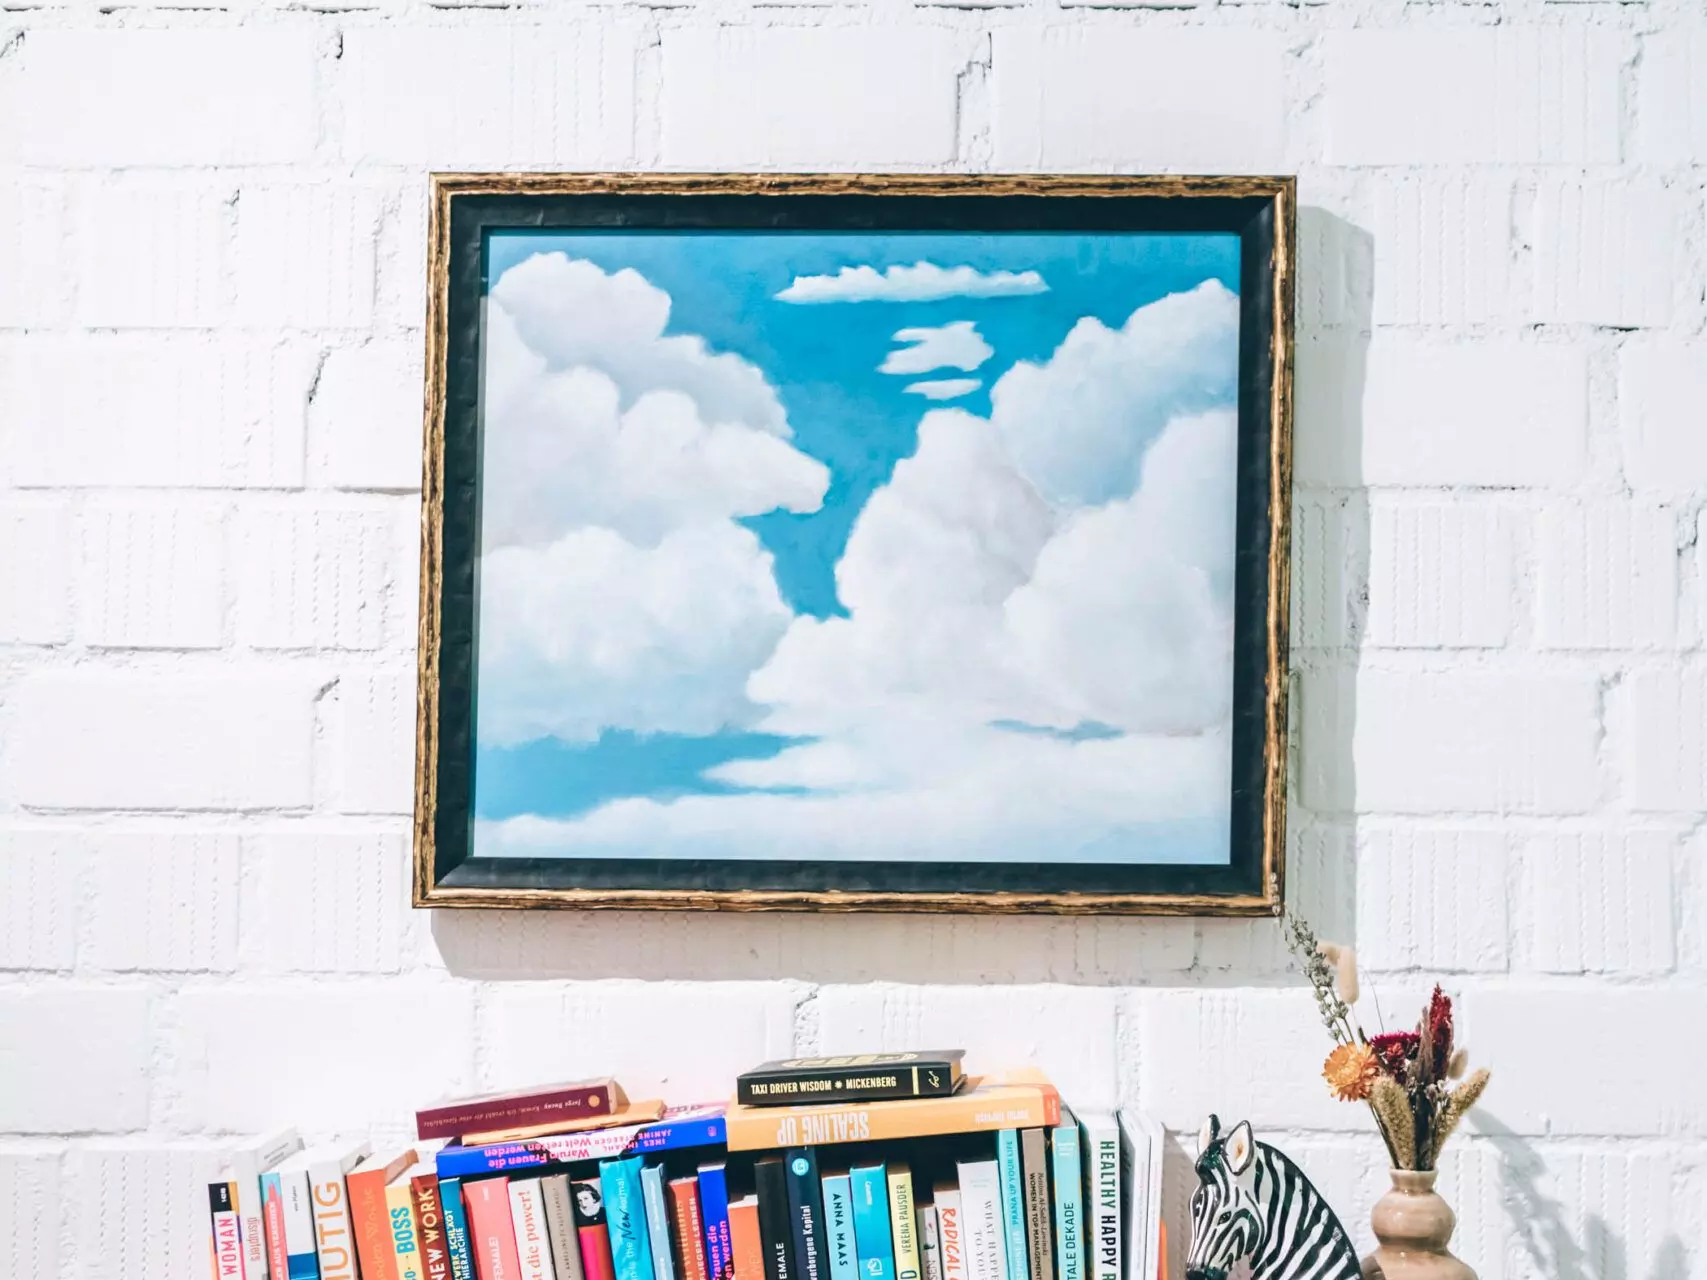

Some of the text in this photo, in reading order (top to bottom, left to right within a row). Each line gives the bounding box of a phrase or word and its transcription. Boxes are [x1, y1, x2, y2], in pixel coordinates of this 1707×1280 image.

[751, 1076, 897, 1094] TAXI DRIVER WISDOM MICKENBERG
[564, 1138, 591, 1146] Welt
[638, 1129, 672, 1139] JANINE
[644, 1138, 666, 1147] INES
[777, 1111, 870, 1146] SCALING UP
[484, 1146, 526, 1157] werden
[488, 1148, 590, 1168] Warum Frauen die
[1007, 1158, 1015, 1180] YOUR
[1100, 1141, 1116, 1208] HEALTHY
[1008, 1183, 1017, 1195] UP
[1030, 1172, 1038, 1201] WOMEN
[419, 1188, 440, 1244] WORK
[518, 1190, 540, 1242] power!
[689, 1197, 700, 1237] LERNEN
[801, 1205, 813, 1235] Kapital
[896, 1184, 911, 1254] VERENA PAUSDER
[984, 1200, 995, 1235] WHAT
[1008, 1196, 1018, 1225] PRANA
[1032, 1202, 1038, 1211] IN
[391, 1206, 415, 1254] BOSS
[444, 1210, 457, 1250] SCHLÄGT
[616, 1208, 636, 1240] New
[707, 1225, 718, 1244] die
[832, 1193, 848, 1266] ANNA MAAS
[942, 1208, 960, 1272] RADICAL
[974, 1230, 982, 1246] TO
[1064, 1202, 1075, 1250] DEKADE
[218, 1218, 239, 1276] WOMAN
[273, 1248, 282, 1266] AUS
[455, 1227, 471, 1279] HIERARCHIE
[625, 1242, 636, 1258] the
[719, 1220, 731, 1263] werden
[1033, 1228, 1042, 1280] MANAGEMENT
[1101, 1215, 1116, 1267] HAPPY
[526, 1246, 540, 1269] die
